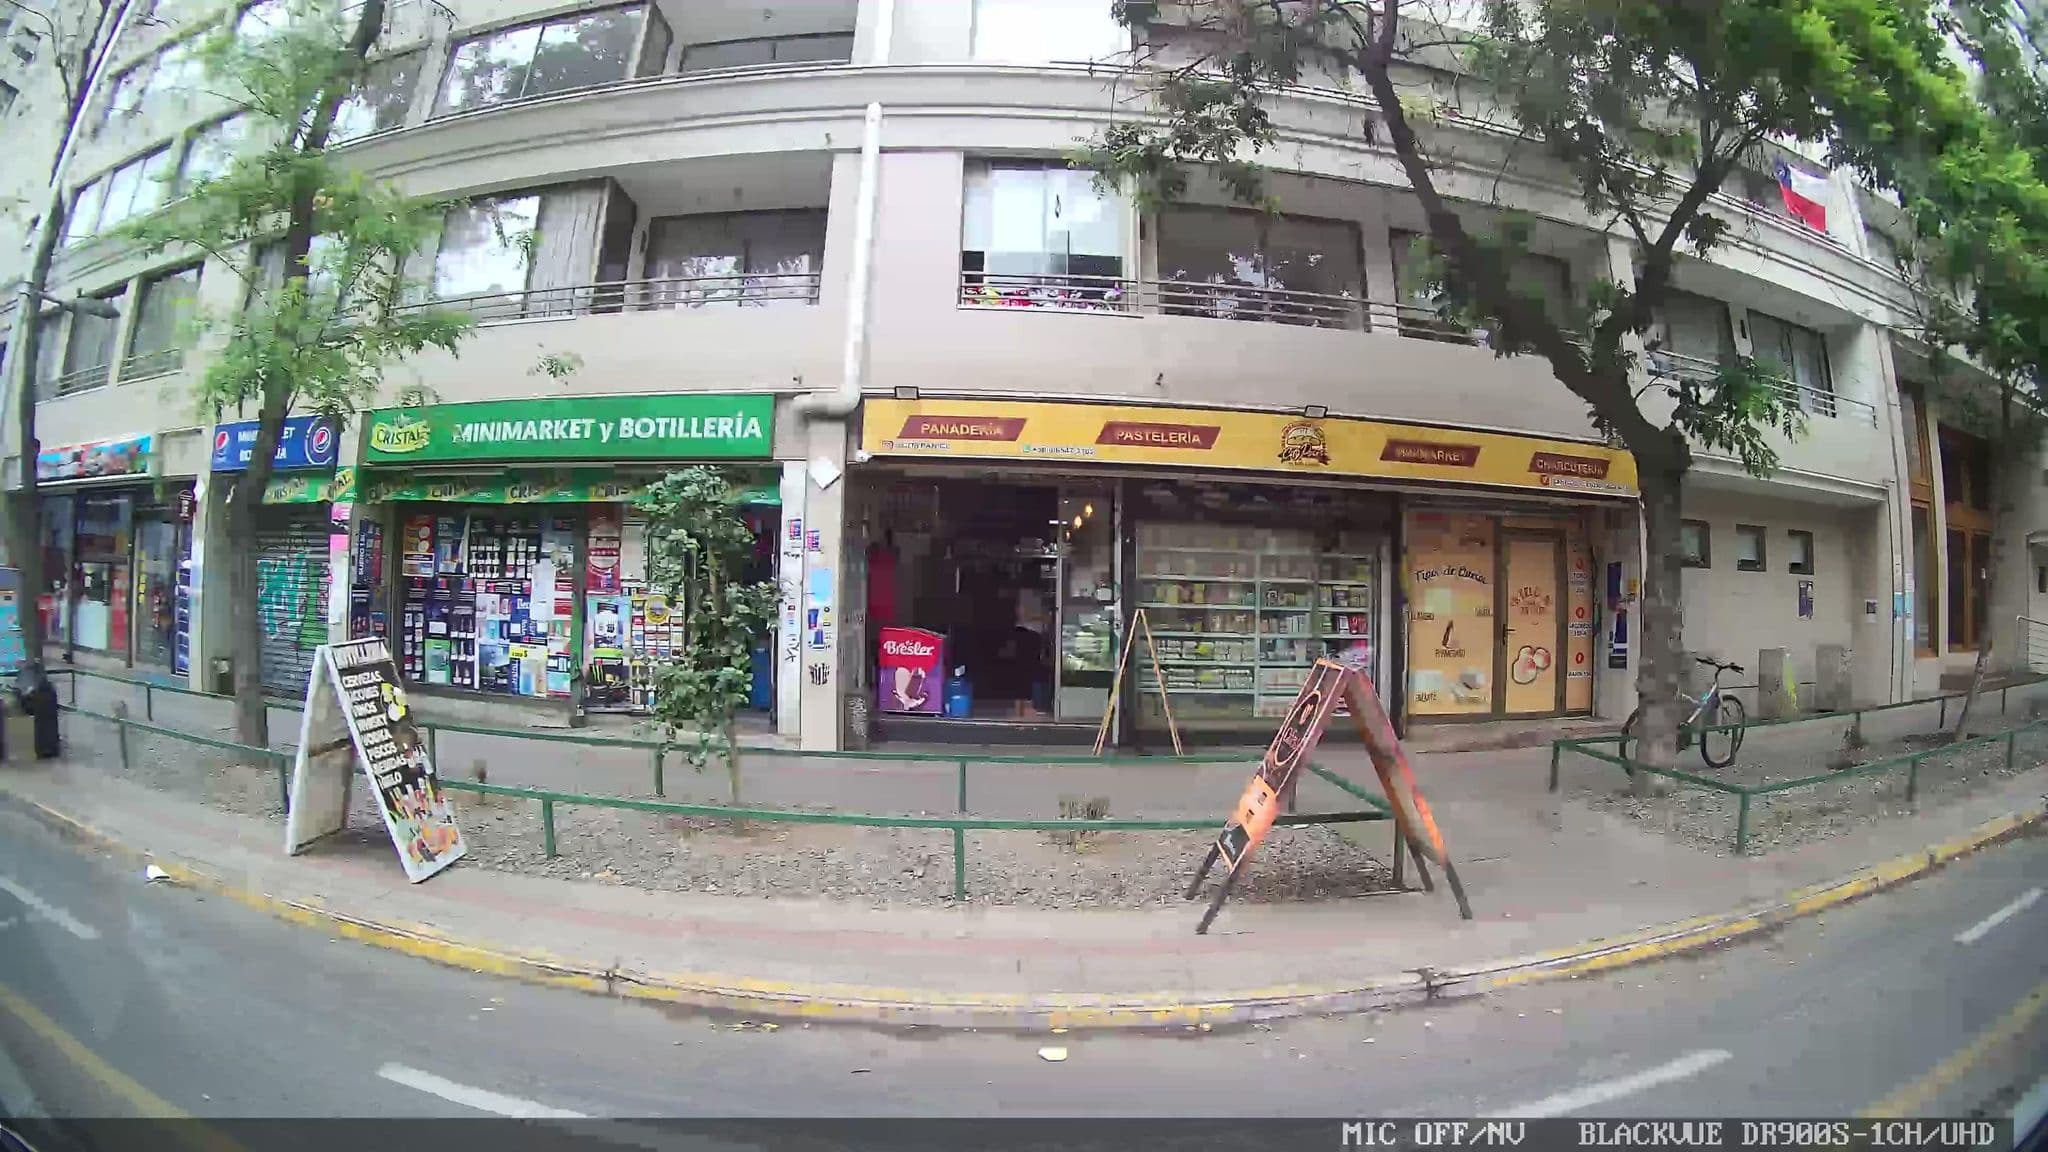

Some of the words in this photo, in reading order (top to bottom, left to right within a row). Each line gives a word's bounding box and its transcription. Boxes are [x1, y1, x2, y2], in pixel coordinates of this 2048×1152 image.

[452, 418, 597, 443] MINIMARKET
[600, 422, 614, 443] y
[619, 411, 762, 438] BOTILLERÍA
[883, 640, 935, 656] Bresler
